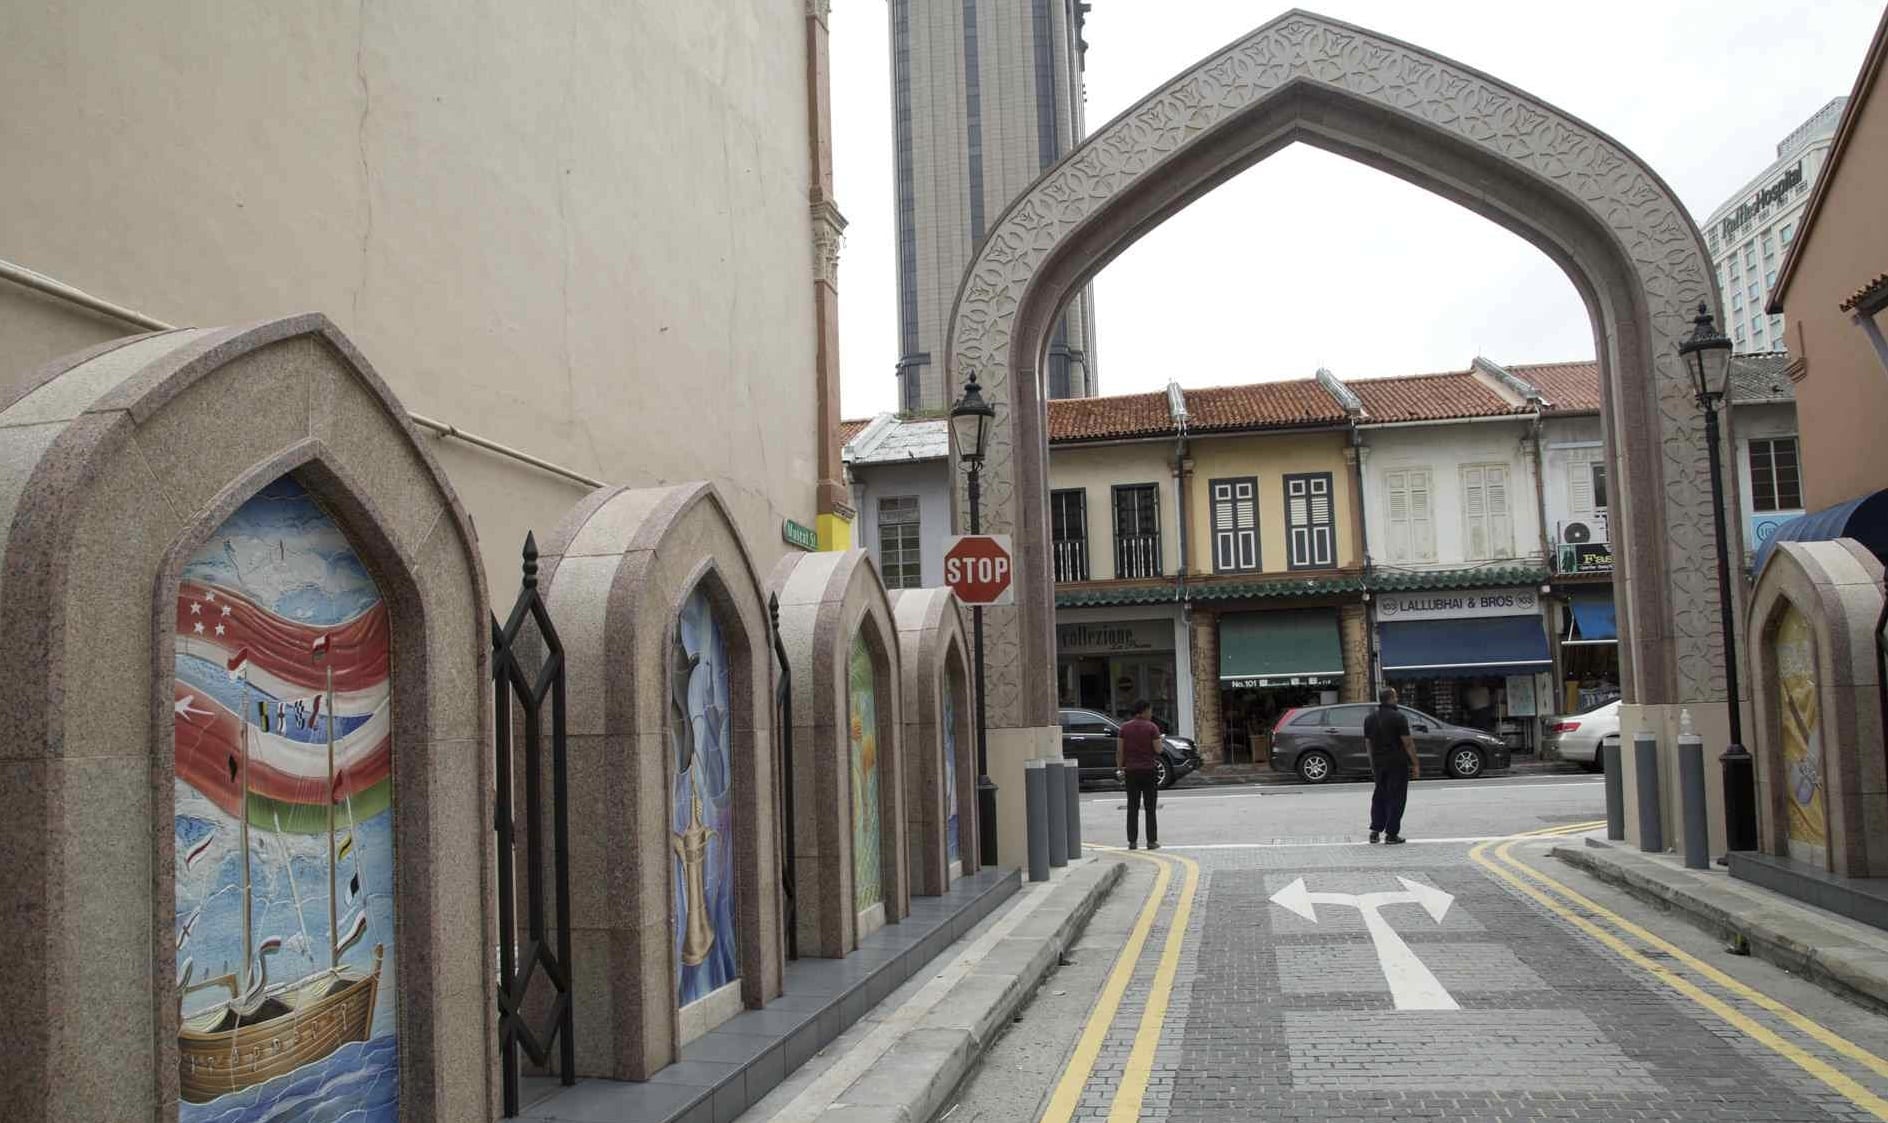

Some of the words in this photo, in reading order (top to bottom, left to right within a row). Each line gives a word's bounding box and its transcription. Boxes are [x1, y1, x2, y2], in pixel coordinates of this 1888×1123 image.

[947, 557, 1008, 583] STOP
[1400, 598, 1463, 612] LALLUBHAI
[1467, 597, 1476, 609] &
[1480, 595, 1514, 608] BROS
